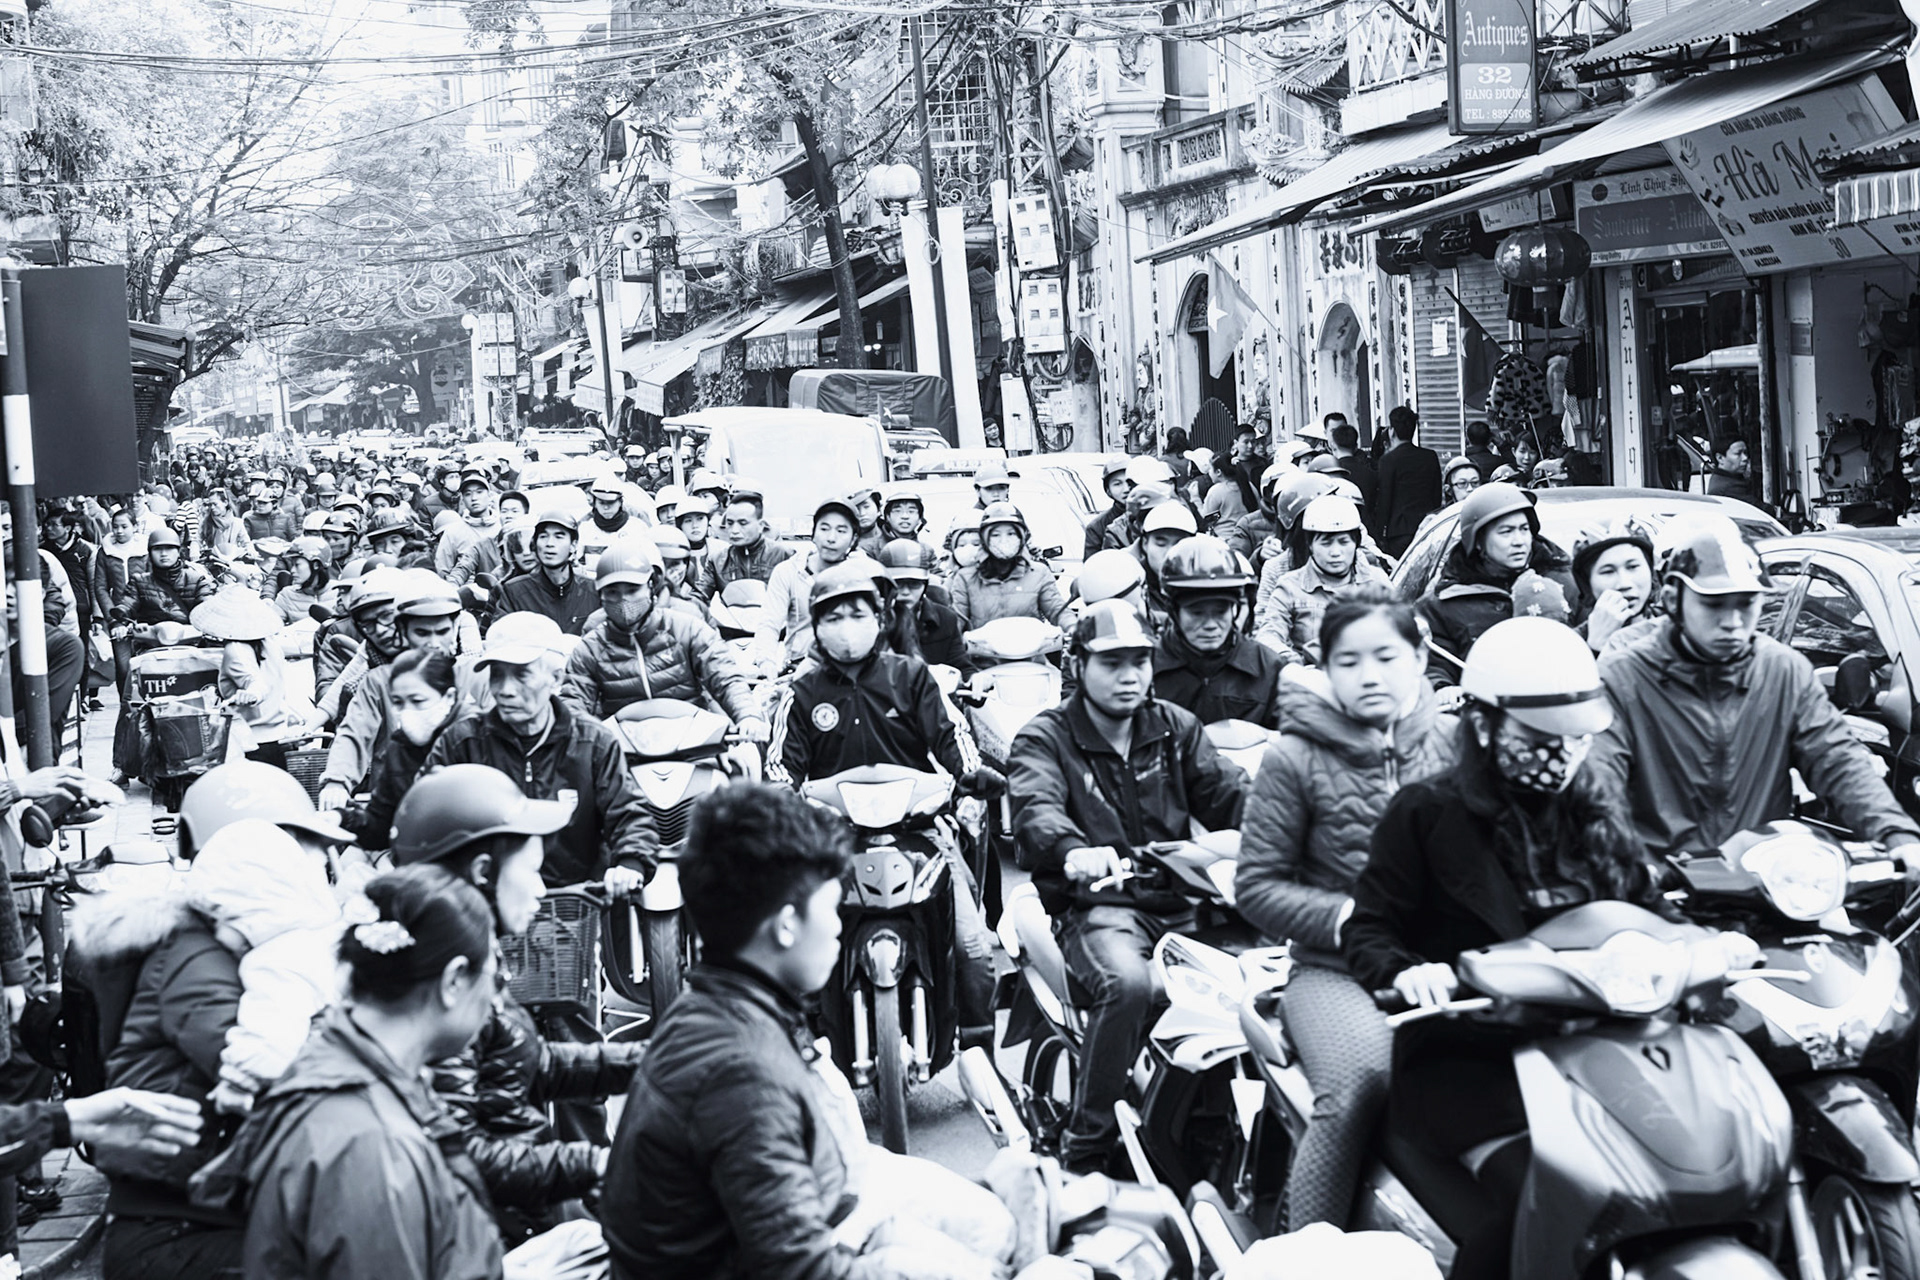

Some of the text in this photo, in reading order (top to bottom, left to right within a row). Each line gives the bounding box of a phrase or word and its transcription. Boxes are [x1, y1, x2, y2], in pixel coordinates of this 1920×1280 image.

[1461, 10, 1529, 56] Antiques
[1478, 66, 1512, 84] 32
[1464, 86, 1492, 100] HÀNG
[1464, 108, 1485, 119] TEL
[1713, 145, 1779, 201] Hà
[1828, 236, 1852, 260] 30
[144, 679, 167, 693] TH
